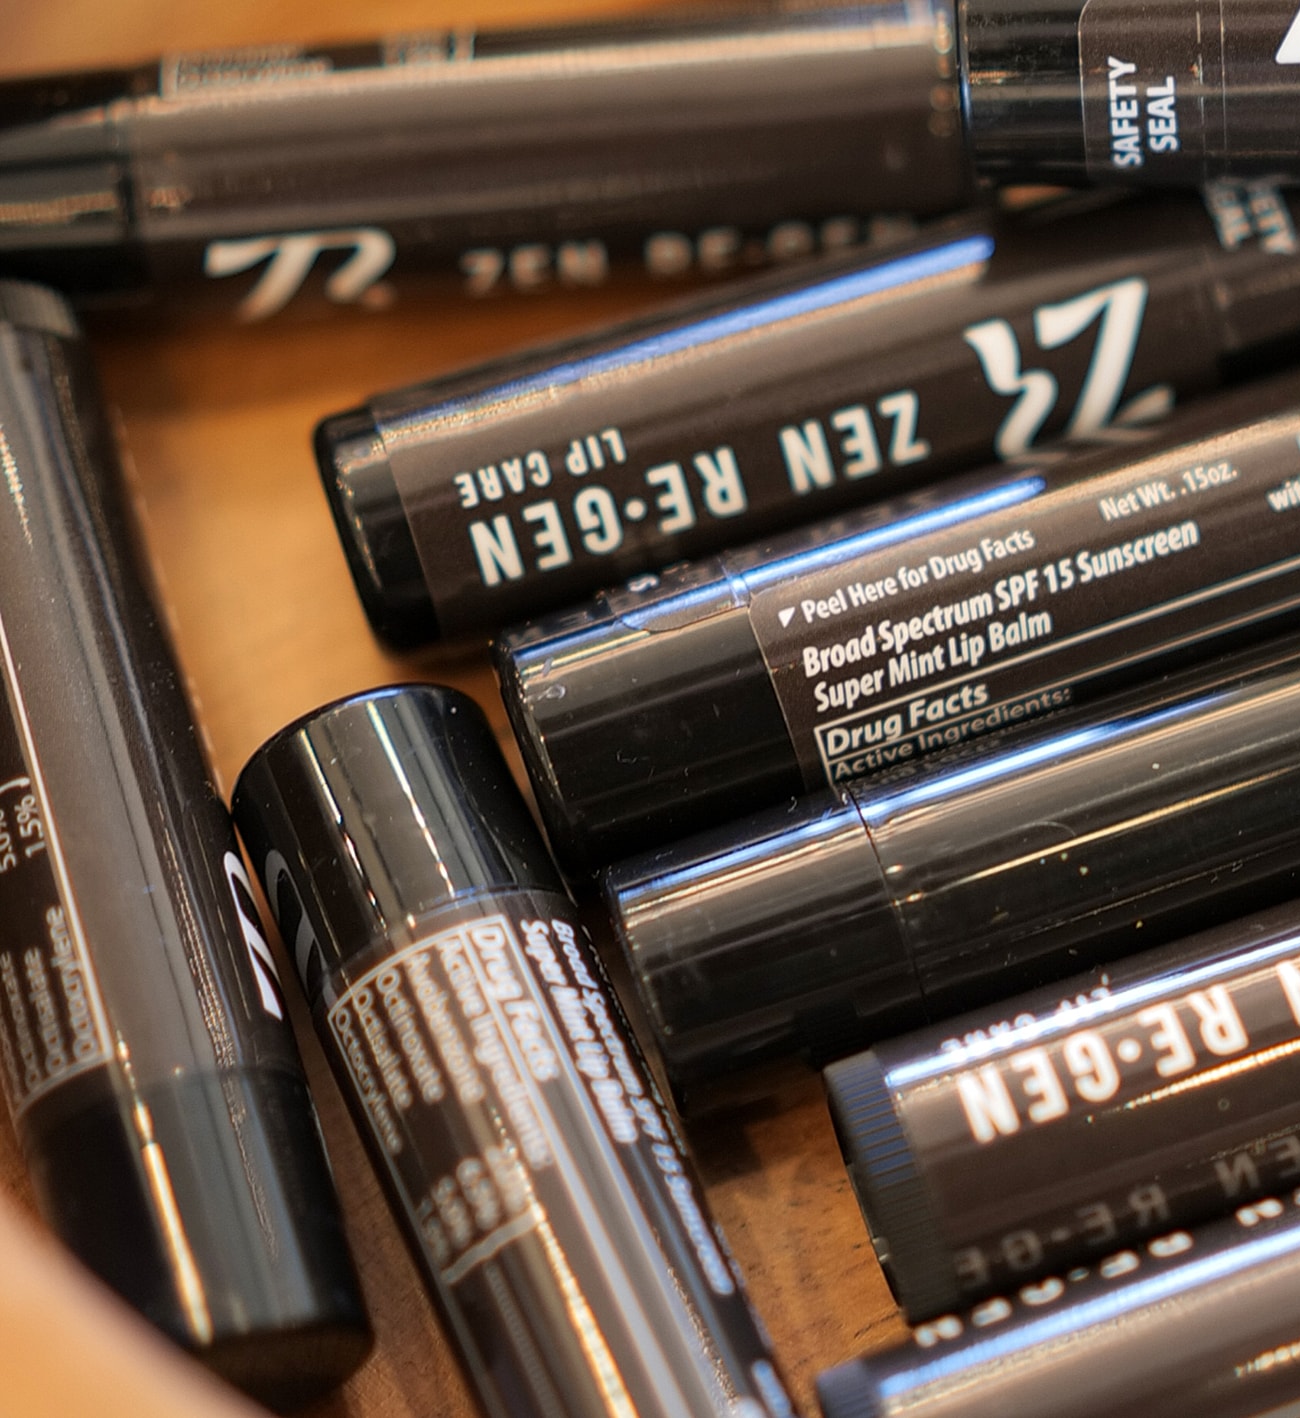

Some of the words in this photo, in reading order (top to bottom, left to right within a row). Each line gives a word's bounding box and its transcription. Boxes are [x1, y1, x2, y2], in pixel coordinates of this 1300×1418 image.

[1108, 56, 1143, 169] SAFETY
[1147, 76, 1178, 152] SEAL
[453, 450, 551, 509] CARE
[565, 427, 627, 477] LIP
[779, 391, 932, 494] ZEN
[1099, 492, 1133, 522] Net
[1133, 480, 1175, 509] Wt.
[1180, 463, 1238, 496] .15oz.
[801, 589, 846, 624] Peel
[848, 574, 897, 614] Here
[898, 562, 930, 592] for
[930, 547, 982, 581] Drug
[980, 528, 1035, 564] Facts
[802, 632, 876, 678] Broad
[877, 593, 993, 655] Spectrum
[995, 575, 1040, 615] SPF
[1042, 564, 1075, 594] 15
[1074, 520, 1199, 584] Sunscreen
[814, 668, 883, 713] Super
[889, 647, 945, 685] Mint
[949, 633, 985, 668] Lip
[988, 610, 1053, 652] Balm
[825, 713, 902, 758] Drug
[908, 682, 988, 723] Facts
[833, 742, 913, 780] Active
[918, 687, 1071, 750] Ingredients:
[439, 936, 486, 1017] Active
[472, 926, 524, 1001] Drug
[504, 1000, 560, 1080] Facts
[521, 919, 567, 986] Super
[551, 986, 595, 1041] Mint
[574, 1041, 610, 1080] Lip
[552, 919, 599, 990] Broad
[582, 988, 643, 1097] Spectrum
